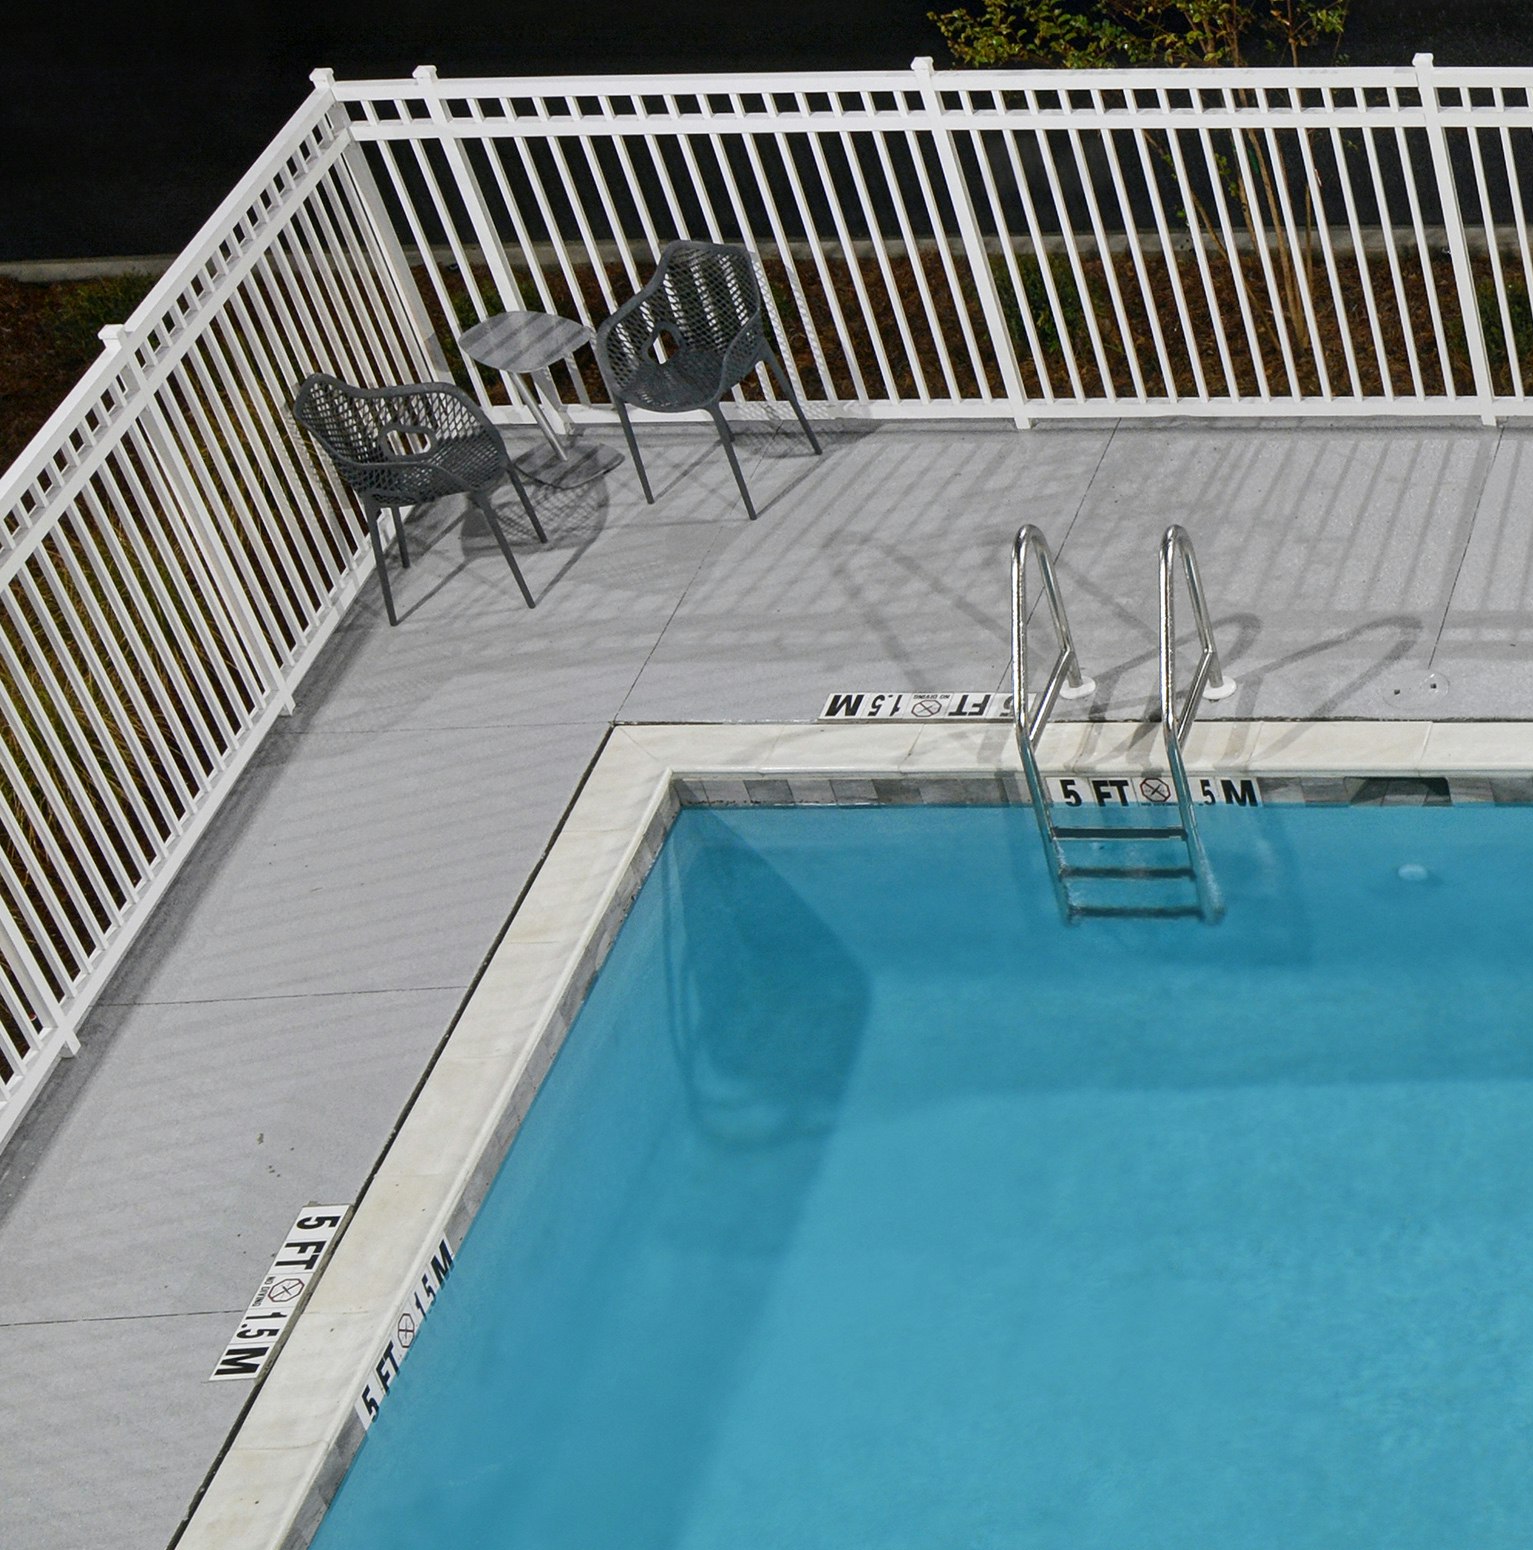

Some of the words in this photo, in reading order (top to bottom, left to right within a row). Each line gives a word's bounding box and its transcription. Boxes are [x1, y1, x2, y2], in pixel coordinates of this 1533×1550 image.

[825, 694, 865, 717] M
[868, 694, 903, 717] 1.5
[948, 694, 991, 716] FT
[1060, 779, 1082, 807] 5
[1092, 780, 1130, 806] FT
[1220, 780, 1258, 806] M
[296, 1215, 342, 1230] 5
[275, 1240, 327, 1270] FT
[264, 1276, 276, 1285] NO
[252, 1287, 270, 1306] DIVING
[236, 1311, 288, 1339] 1.5
[361, 1384, 379, 1423] 5
[376, 1340, 400, 1396] FT
[430, 1239, 454, 1290] M
[214, 1346, 270, 1376] M
